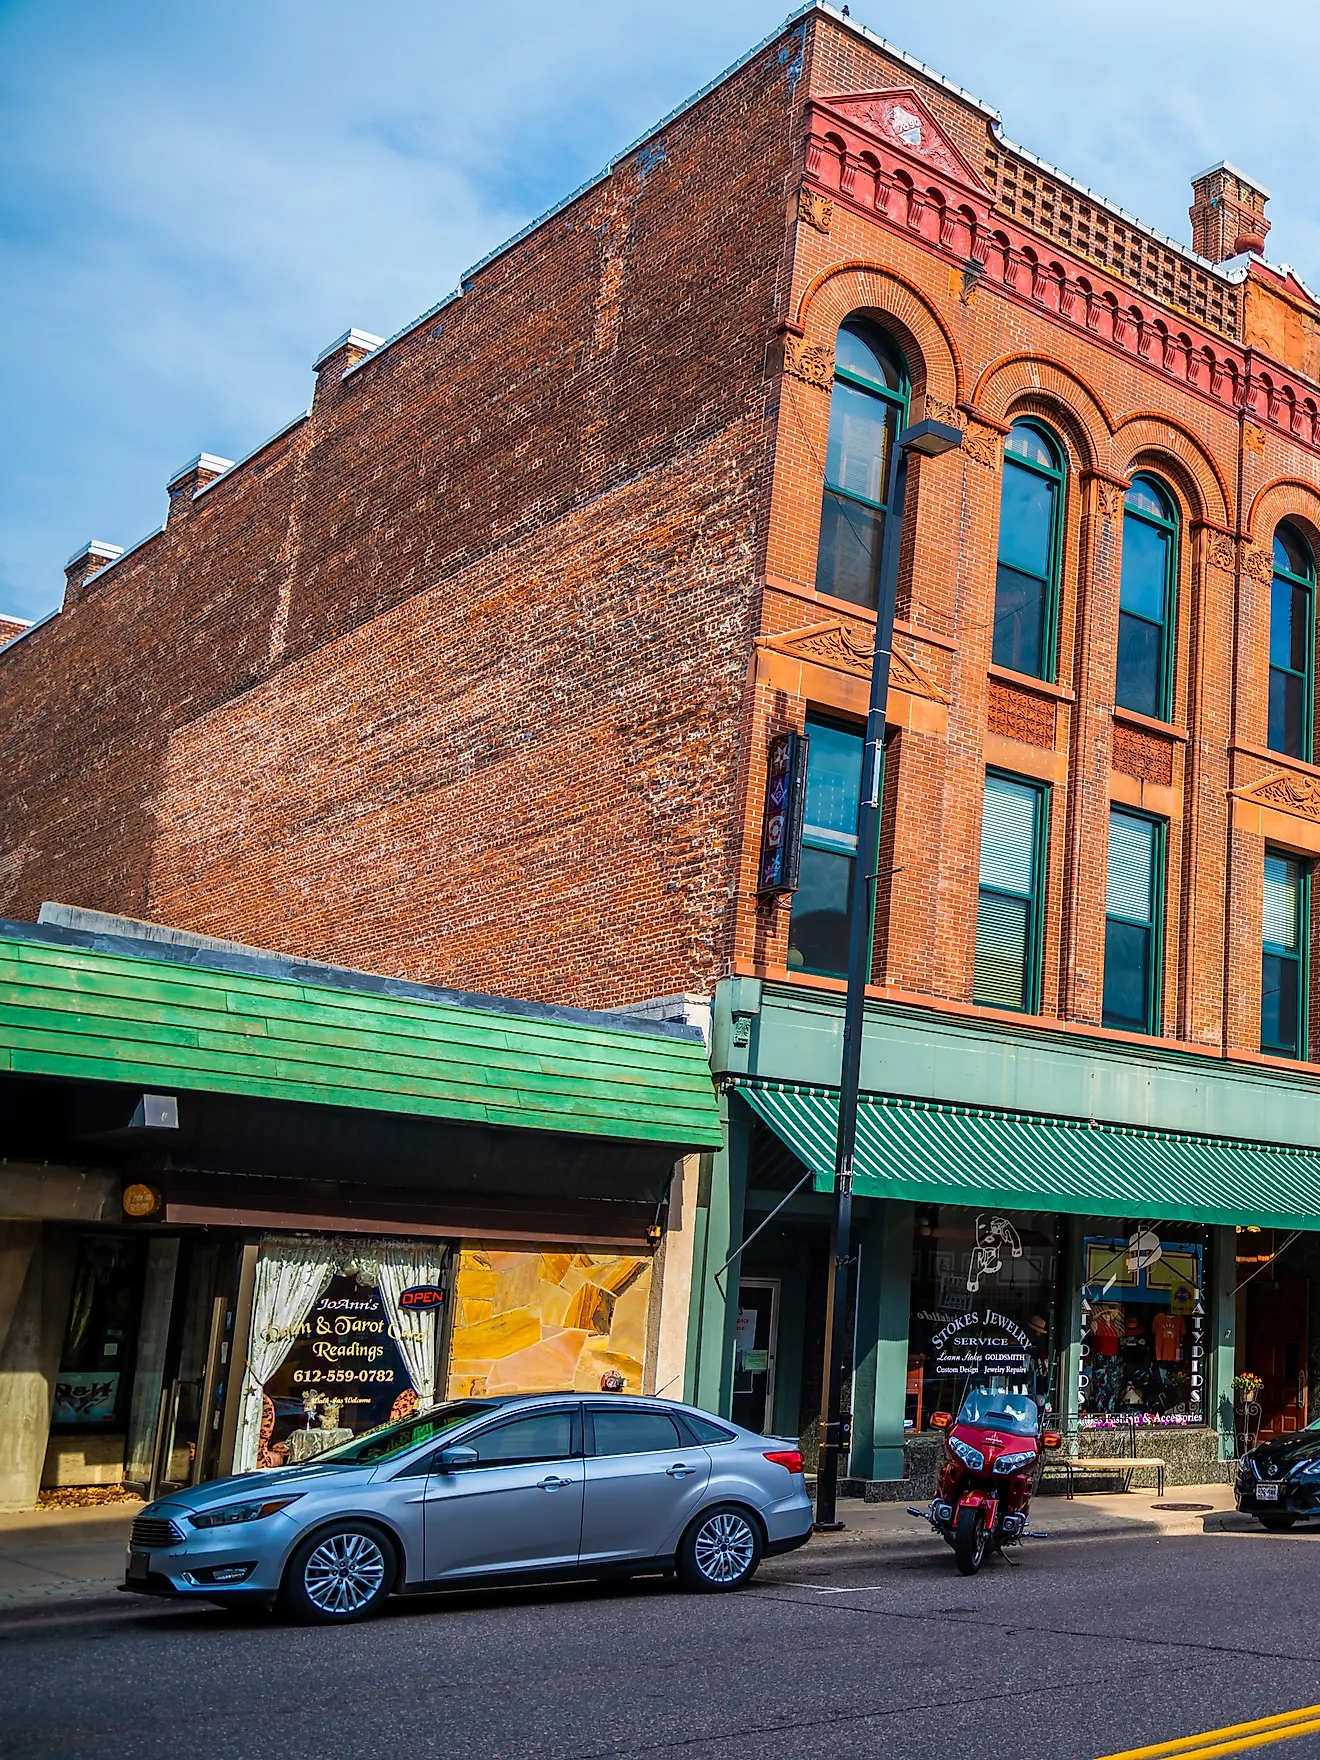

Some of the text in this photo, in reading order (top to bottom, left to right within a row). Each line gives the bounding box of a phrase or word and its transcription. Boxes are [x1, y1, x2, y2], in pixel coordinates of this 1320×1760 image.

[317, 1298, 379, 1311] JoAnn's
[402, 1291, 443, 1305] OPEN
[316, 1315, 333, 1335] &
[334, 1316, 385, 1336] Tarot
[931, 1309, 1032, 1351] STOKES JEWELRY
[953, 1337, 1009, 1346] SERVICE
[1190, 1288, 1205, 1403] KATYDIDS
[312, 1341, 384, 1363] Readings
[961, 1349, 983, 1361] Stokes
[984, 1353, 1026, 1361] GOLDSMITH
[293, 1369, 395, 1383] 612-559-0782
[936, 1365, 1027, 1374] Custom Design Jewelry Repairs
[344, 1396, 372, 1404] Welcome
[1141, 1412, 1151, 1423] &
[1153, 1411, 1203, 1423] Accessories
